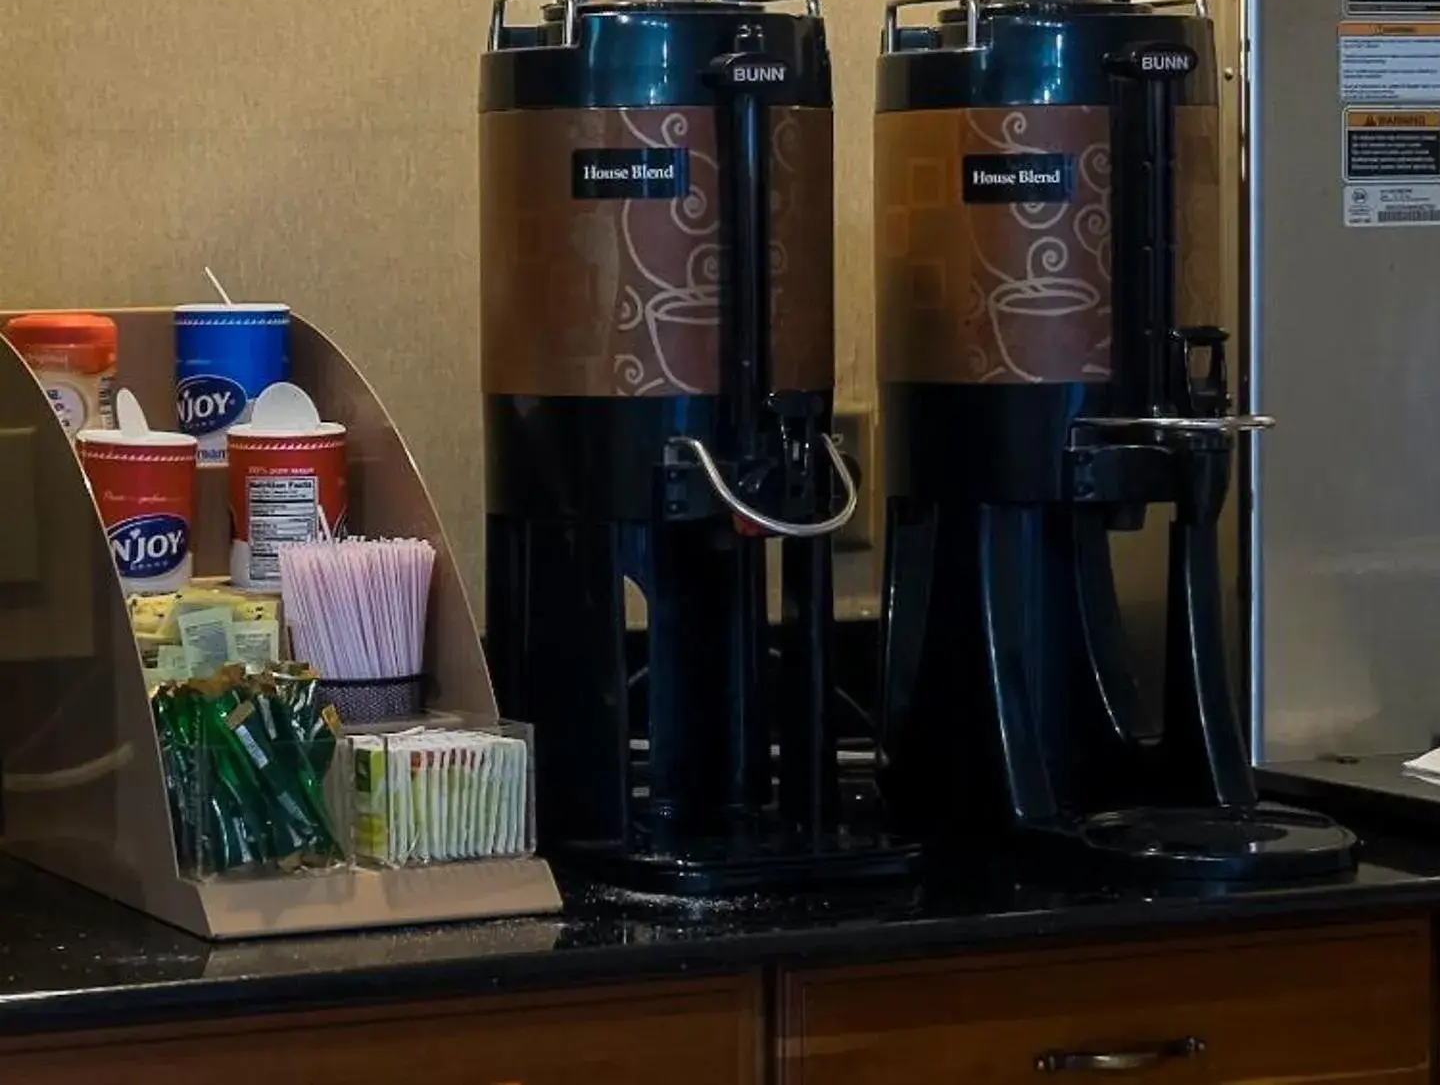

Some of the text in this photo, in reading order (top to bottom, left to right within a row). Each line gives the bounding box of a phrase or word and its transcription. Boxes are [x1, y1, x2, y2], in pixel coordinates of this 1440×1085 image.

[1142, 56, 1189, 71] BUNN
[734, 67, 785, 82] BUNN
[584, 165, 675, 180] House Blend
[973, 170, 1061, 185] House Blend
